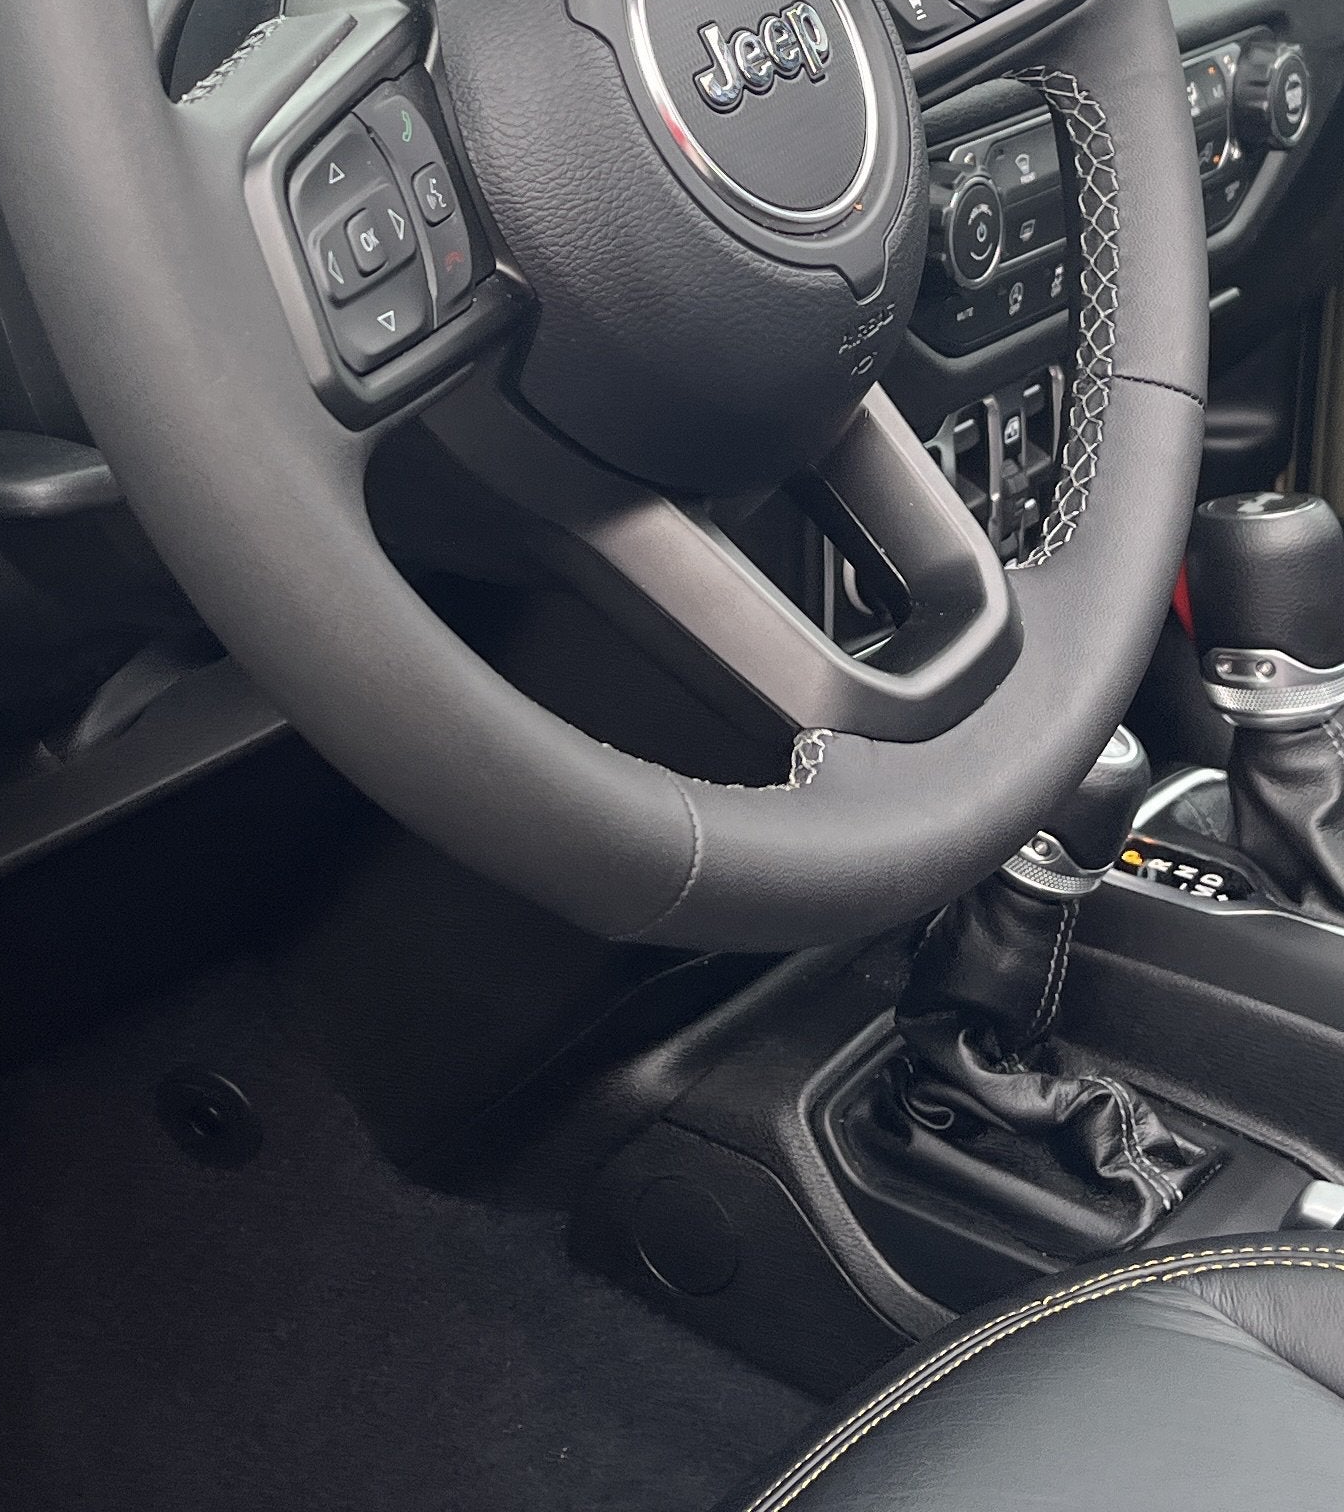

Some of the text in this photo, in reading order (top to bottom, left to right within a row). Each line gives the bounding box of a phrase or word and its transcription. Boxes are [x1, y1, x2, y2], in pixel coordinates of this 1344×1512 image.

[698, 1, 829, 108] Jeep
[360, 227, 380, 252] OK
[1200, 873, 1224, 888] D
